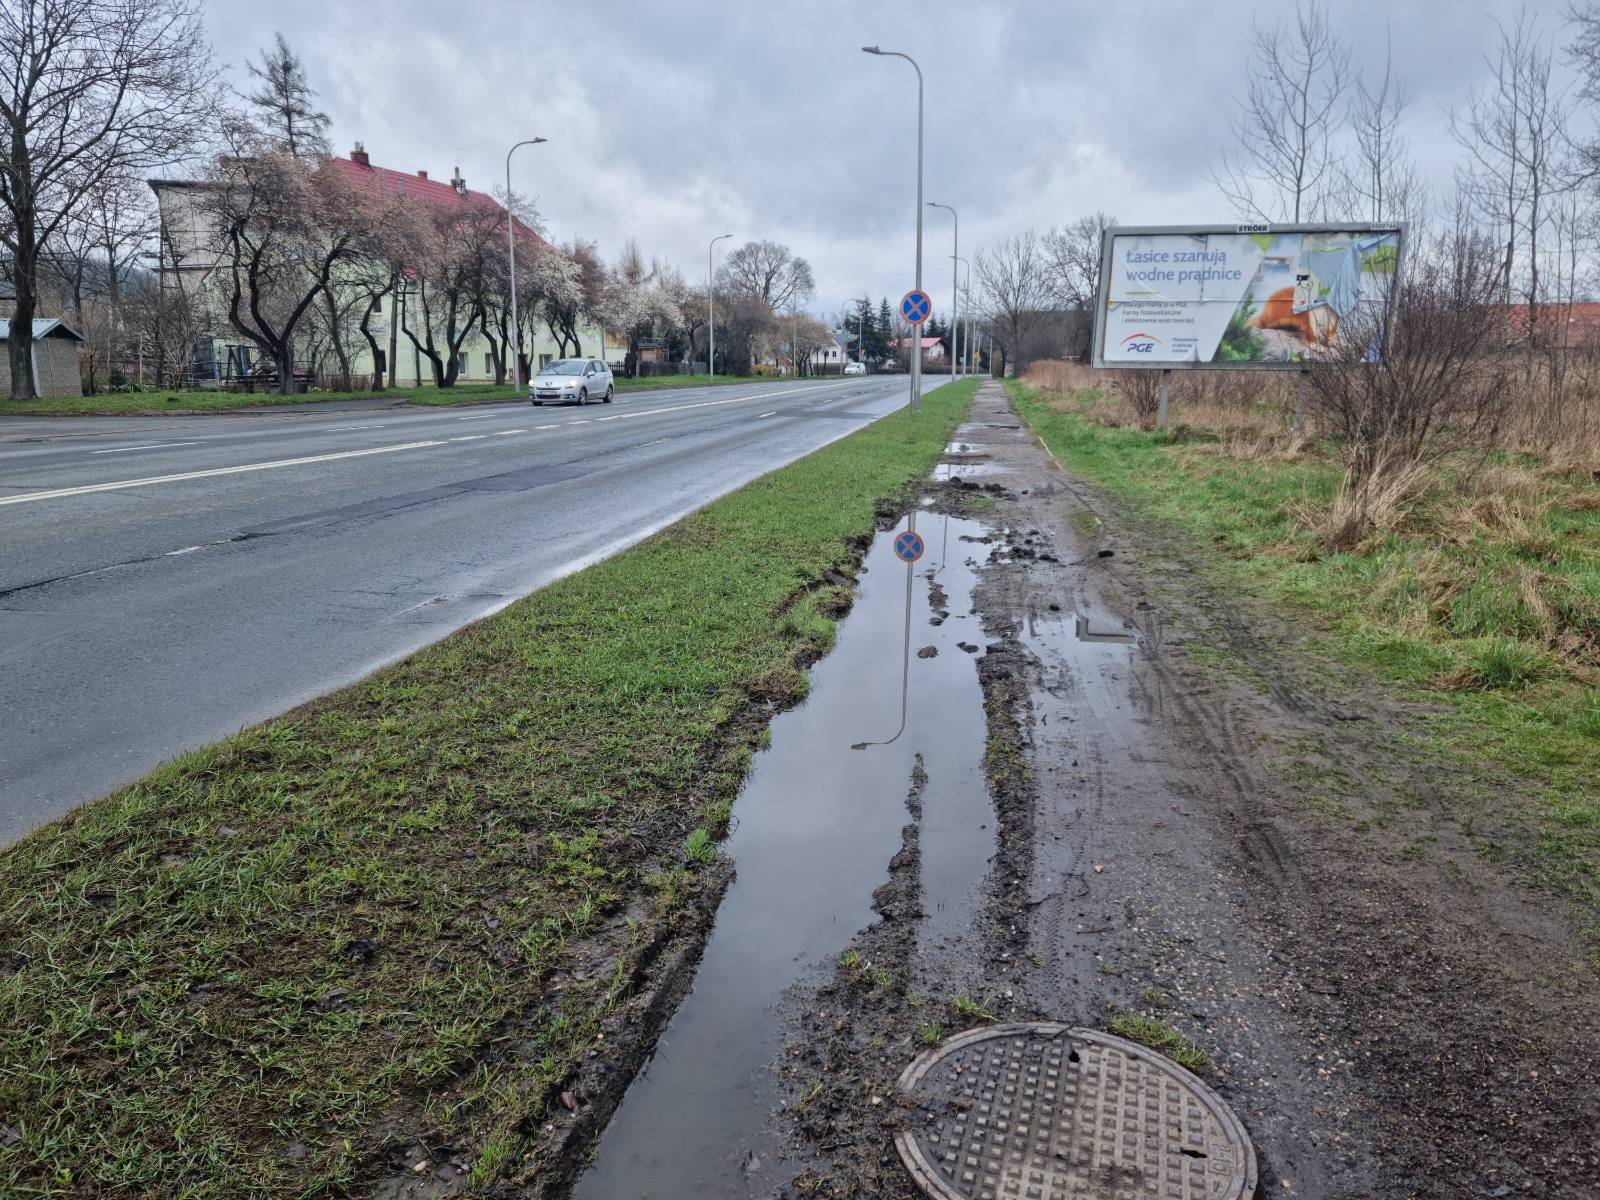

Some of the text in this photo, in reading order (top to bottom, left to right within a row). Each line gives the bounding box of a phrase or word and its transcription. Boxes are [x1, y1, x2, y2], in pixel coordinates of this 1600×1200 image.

[1126, 249, 1227, 265] Łasice szanują
[1126, 267, 1242, 284] wodne prądnice
[1127, 343, 1154, 352] PGE
